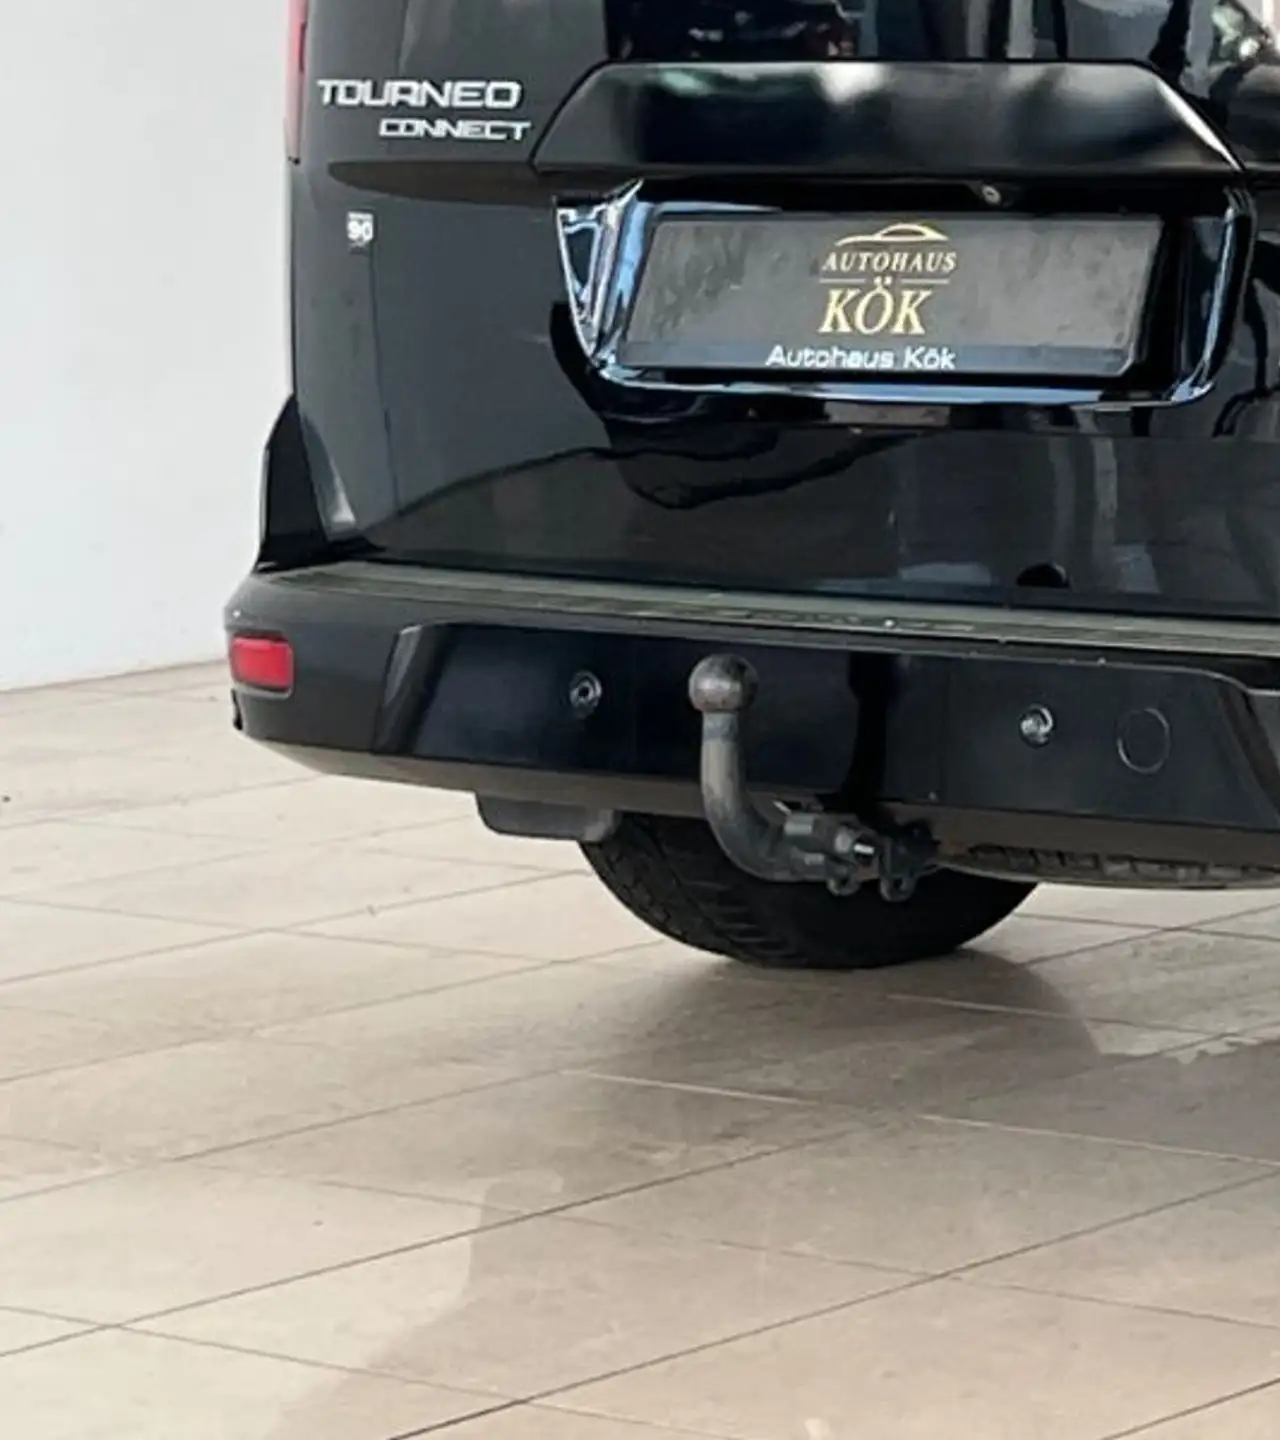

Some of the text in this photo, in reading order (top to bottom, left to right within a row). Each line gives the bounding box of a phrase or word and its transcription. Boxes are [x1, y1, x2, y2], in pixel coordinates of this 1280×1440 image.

[316, 78, 523, 110] TOURNEO
[378, 117, 533, 141] CONNECT
[821, 251, 958, 274] AUTOHAUS
[817, 275, 933, 336] KÖK
[765, 344, 957, 370] Autohaus Kök
